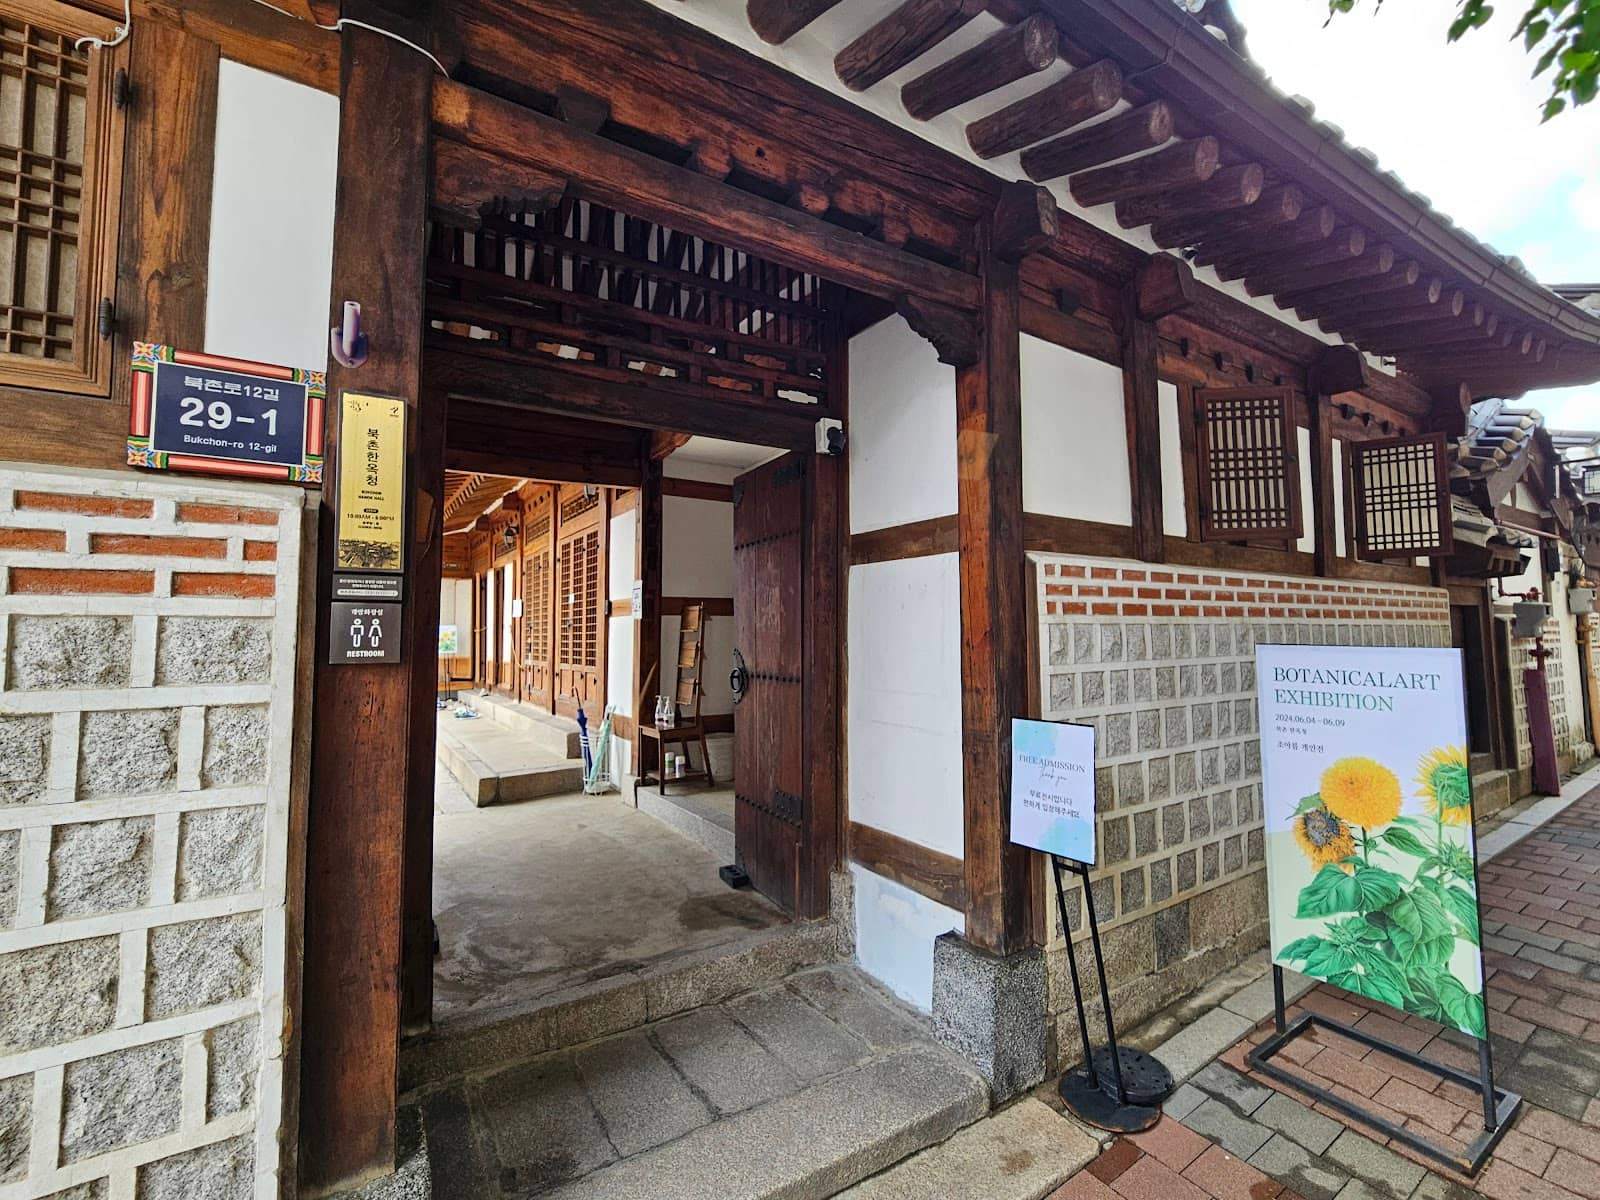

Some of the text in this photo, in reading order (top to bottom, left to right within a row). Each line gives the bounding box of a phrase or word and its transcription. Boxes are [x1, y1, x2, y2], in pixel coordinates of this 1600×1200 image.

[184, 375, 280, 401] 북촌로12길
[179, 396, 278, 436] 29-1
[183, 434, 278, 454] Bukchon-ro 12-gil
[365, 427, 380, 487] 북촌한옥청
[346, 650, 385, 658] RESTROOM
[1274, 688, 1394, 712] EXHIBITION
